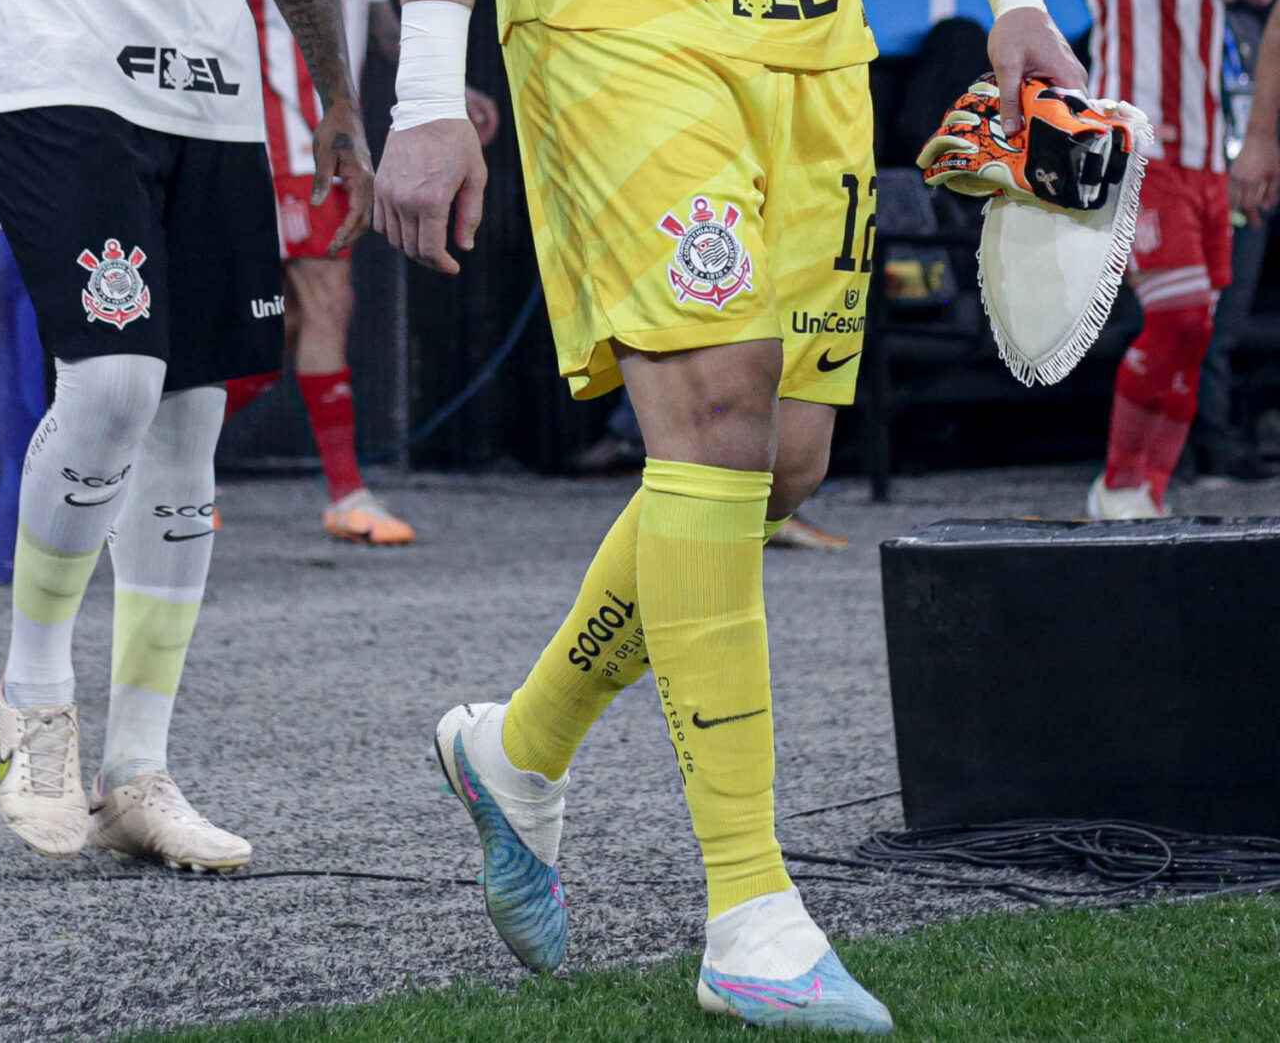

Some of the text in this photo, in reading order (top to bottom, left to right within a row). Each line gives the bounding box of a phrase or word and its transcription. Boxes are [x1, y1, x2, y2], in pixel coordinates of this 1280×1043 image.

[116, 44, 240, 96] FIEL
[568, 590, 635, 672] TODOS
[601, 626, 646, 678] artão de
[658, 676, 695, 774] Cartão de
